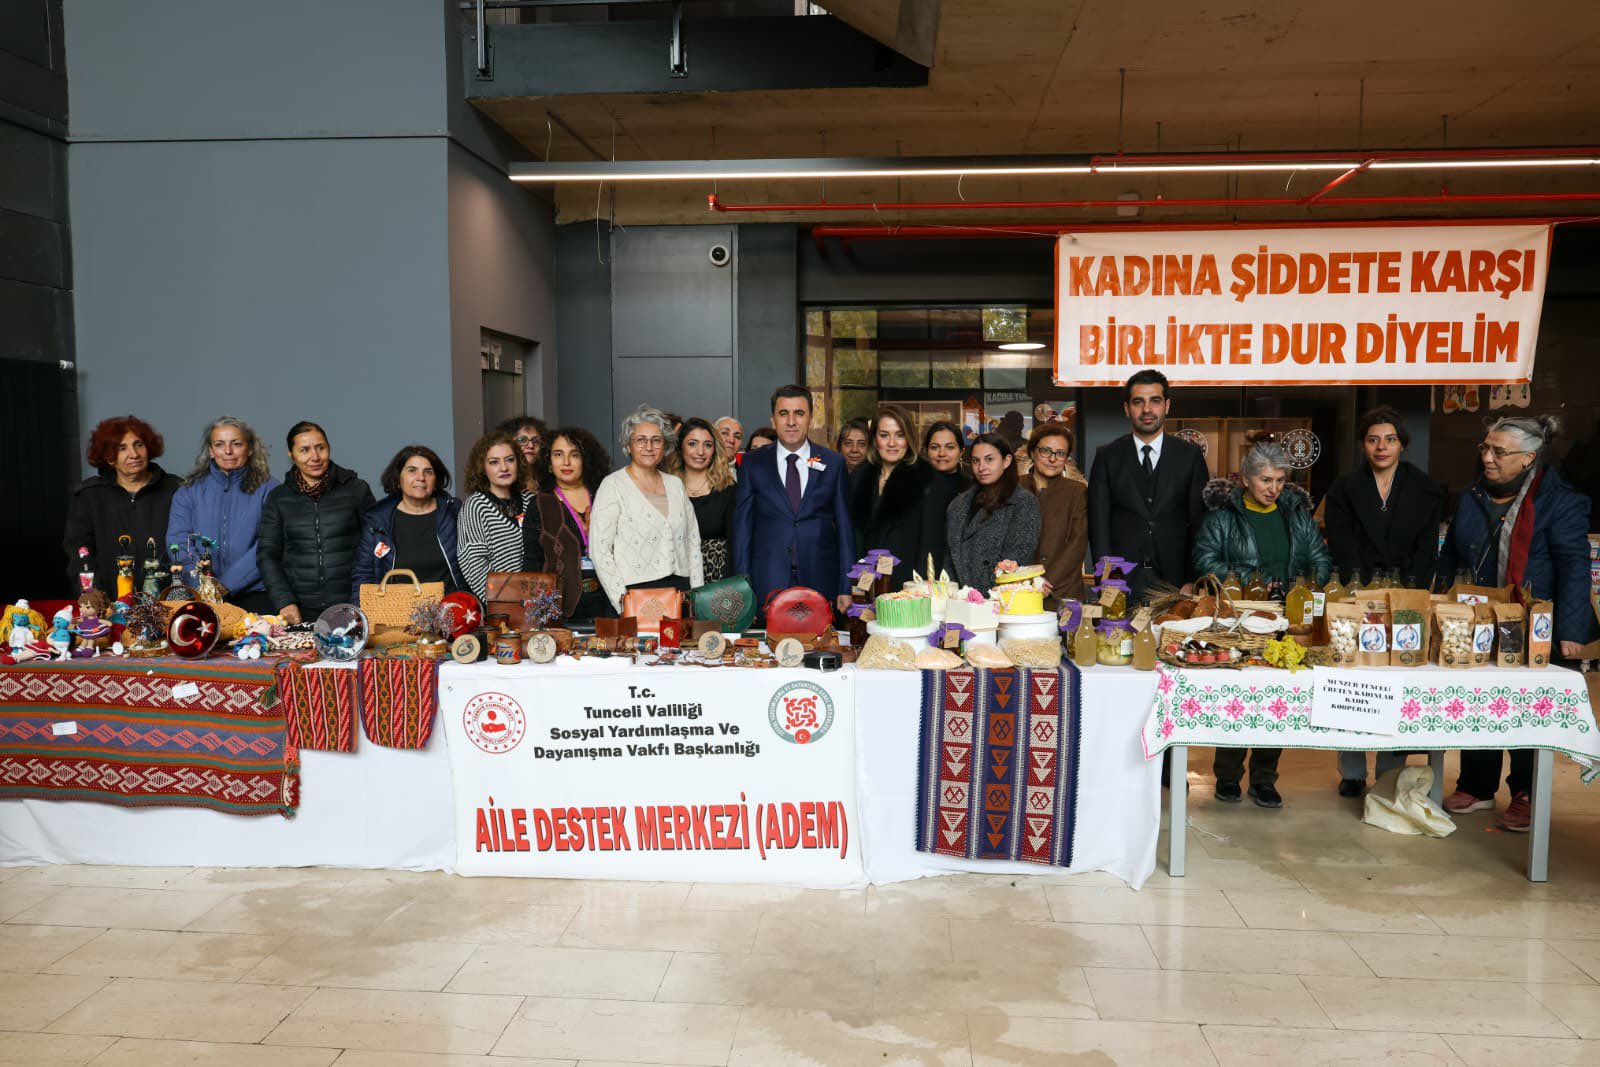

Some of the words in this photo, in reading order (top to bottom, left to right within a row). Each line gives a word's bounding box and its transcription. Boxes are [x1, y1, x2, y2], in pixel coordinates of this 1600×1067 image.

[1069, 254, 1222, 297] KADINA
[1230, 245, 1402, 302] ŞİDDETE
[1410, 250, 1536, 300] KARŞI
[1079, 316, 1252, 366] BİRLİKTE
[1261, 322, 1347, 365] DUR
[1355, 313, 1520, 364] DİYELİM
[583, 705, 642, 719] Tunceli
[645, 703, 703, 720] Valiliği
[550, 726, 604, 742] Sosyal
[609, 724, 714, 741] Yardımlaşma
[718, 722, 740, 735] Ve
[533, 745, 623, 761] Dayanışma
[627, 743, 670, 757] Vakfı
[674, 741, 760, 758] Başkanlığı
[475, 796, 530, 852] AİLE
[533, 807, 632, 851] DESTEK
[634, 792, 750, 850] MERKEZİ
[755, 801, 848, 860] (ADEM)
